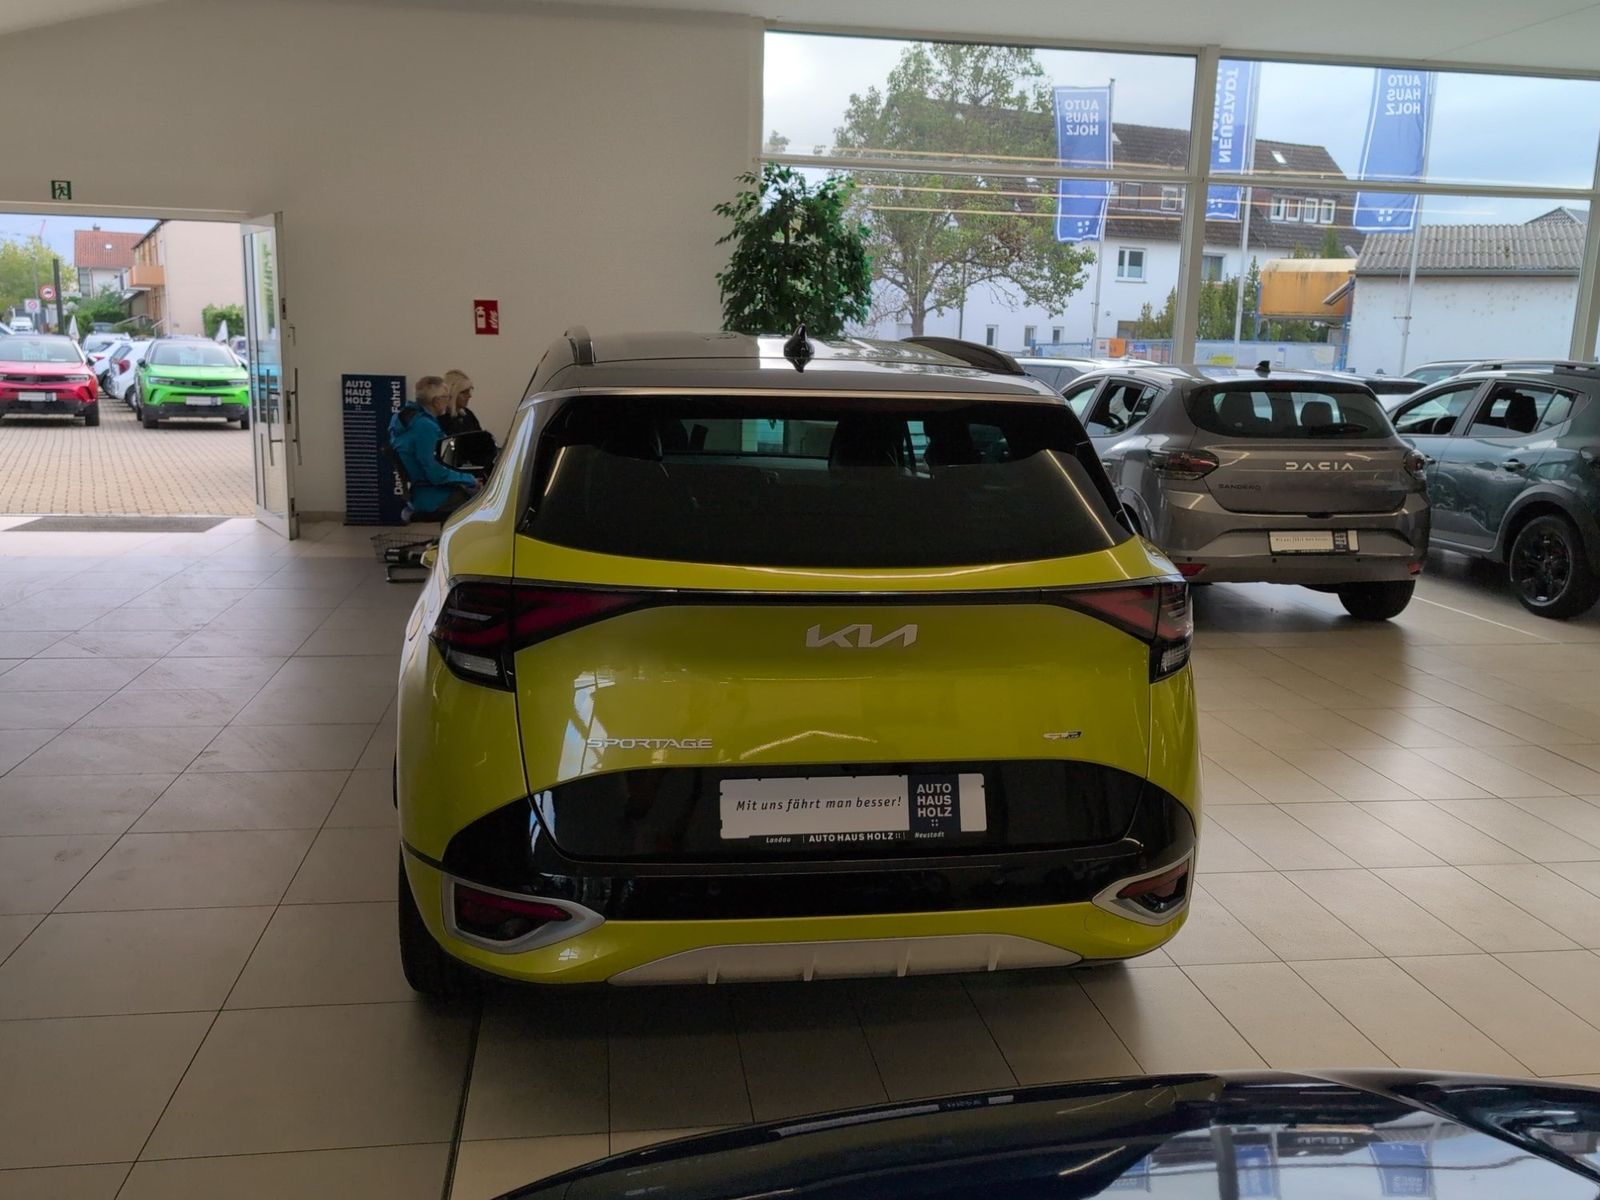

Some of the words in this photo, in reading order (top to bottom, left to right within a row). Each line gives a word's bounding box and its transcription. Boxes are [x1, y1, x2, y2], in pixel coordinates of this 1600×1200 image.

[345, 380, 372, 388] AUTO
[345, 388, 372, 397] HAUS
[345, 397, 372, 405] HOLZ
[1285, 461, 1354, 471] DACIA
[805, 623, 919, 649] KIA
[586, 737, 714, 750] SPORTAGE
[916, 783, 952, 794] AUTO
[736, 799, 757, 811] Mit
[761, 801, 783, 811] uns
[785, 798, 821, 812] fährt
[826, 799, 852, 809] man
[856, 796, 902, 808] besser!
[917, 795, 952, 806] HAUS
[917, 806, 952, 818] HOLZ
[765, 836, 791, 844] Landau
[867, 831, 894, 841] HOLZ
[914, 831, 945, 839] Neustadt
